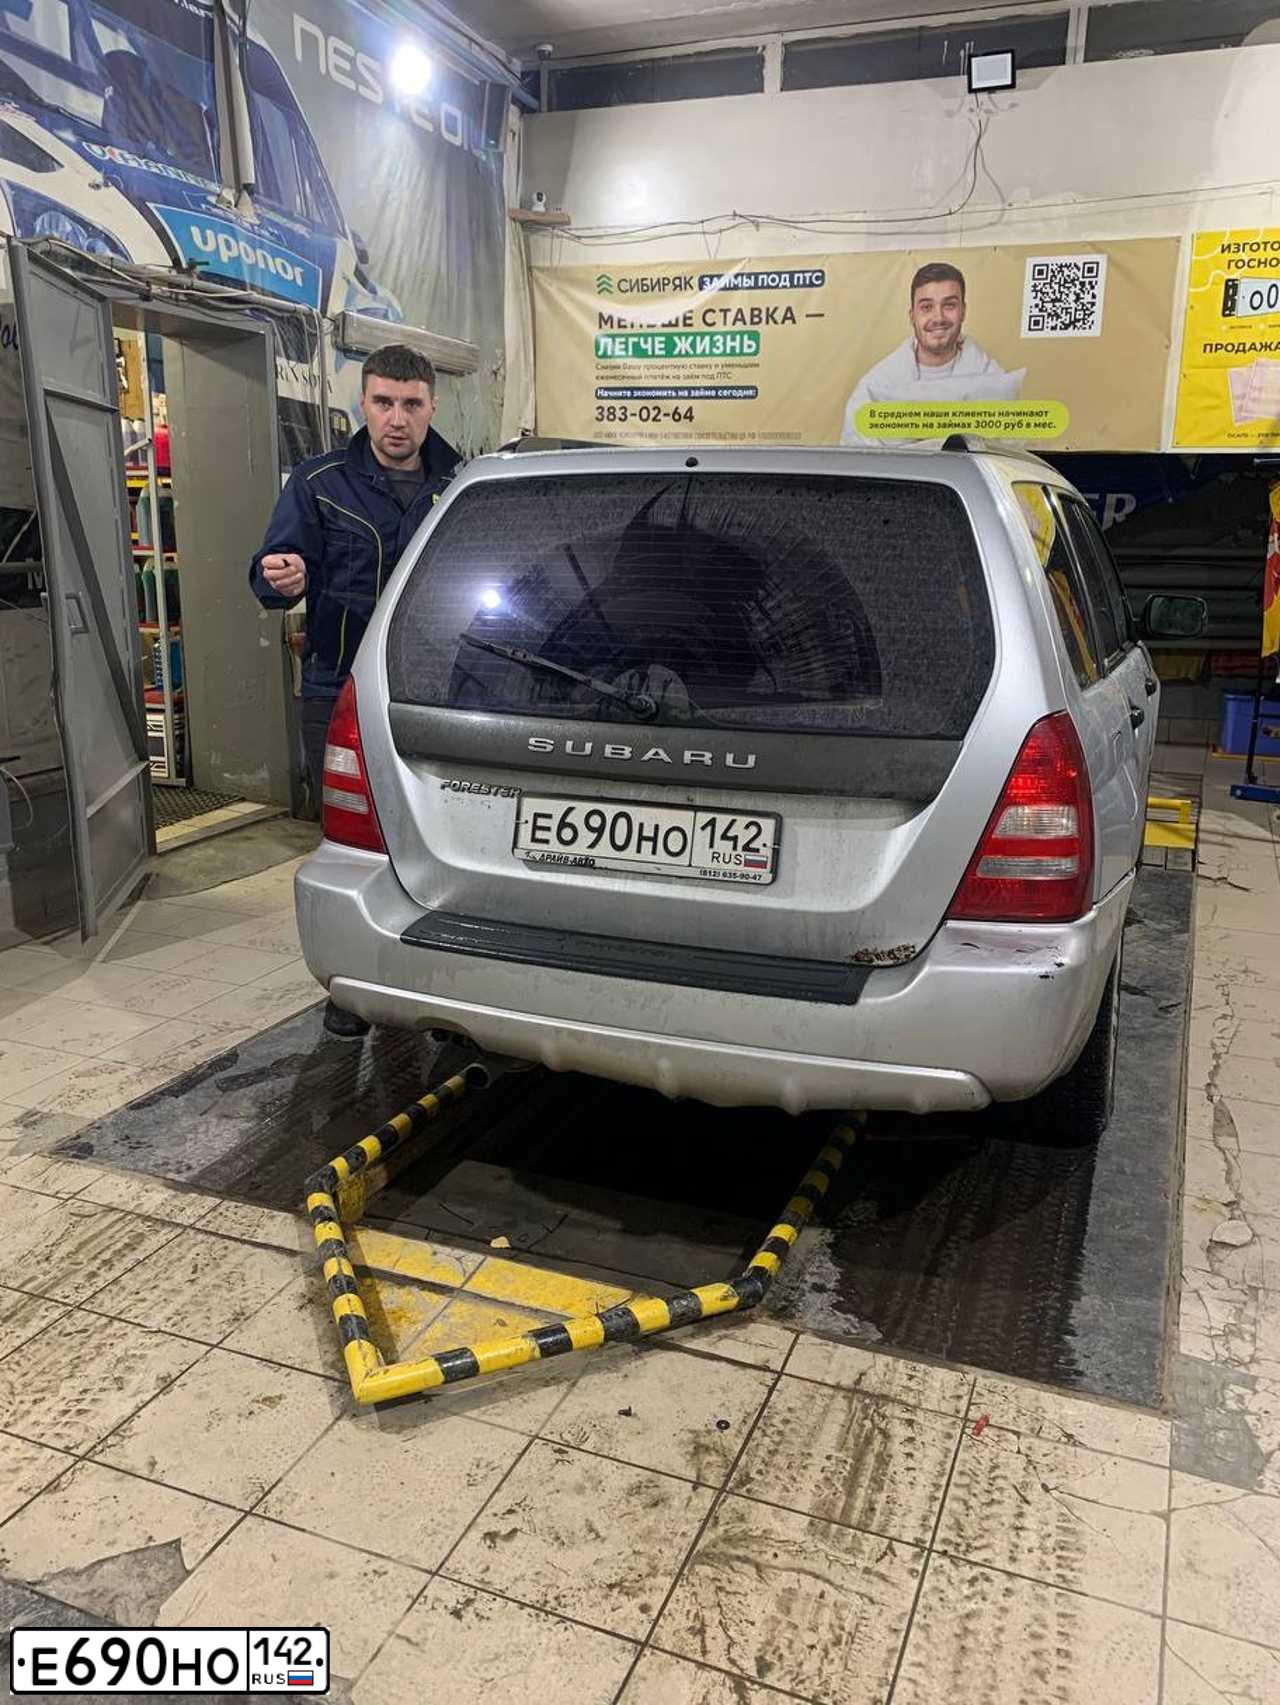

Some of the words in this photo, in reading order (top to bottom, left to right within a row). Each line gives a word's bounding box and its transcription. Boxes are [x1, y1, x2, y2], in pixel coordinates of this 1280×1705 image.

[190, 225, 304, 287] uponor
[616, 276, 695, 294] СИБИРЯК
[758, 273, 791, 288] ПОД
[793, 271, 823, 285] ПТС
[701, 306, 798, 328] СТАВКА
[597, 335, 667, 356] ЛЕГЧЕ
[672, 333, 758, 355] ЖИЗНЬ
[716, 371, 733, 380] ПТС
[595, 405, 694, 422] 383-02-64
[878, 411, 921, 420] среднем
[998, 410, 1050, 418] начинают
[937, 420, 972, 429] займах
[974, 420, 1001, 429] 3000
[1003, 420, 1024, 431] руб
[1033, 421, 1057, 429] мес.
[527, 737, 757, 769] SUBARU
[440, 780, 522, 799] FORESTER
[530, 806, 688, 858] Е690НО
[700, 817, 763, 853] 142
[711, 851, 743, 866] RUS
